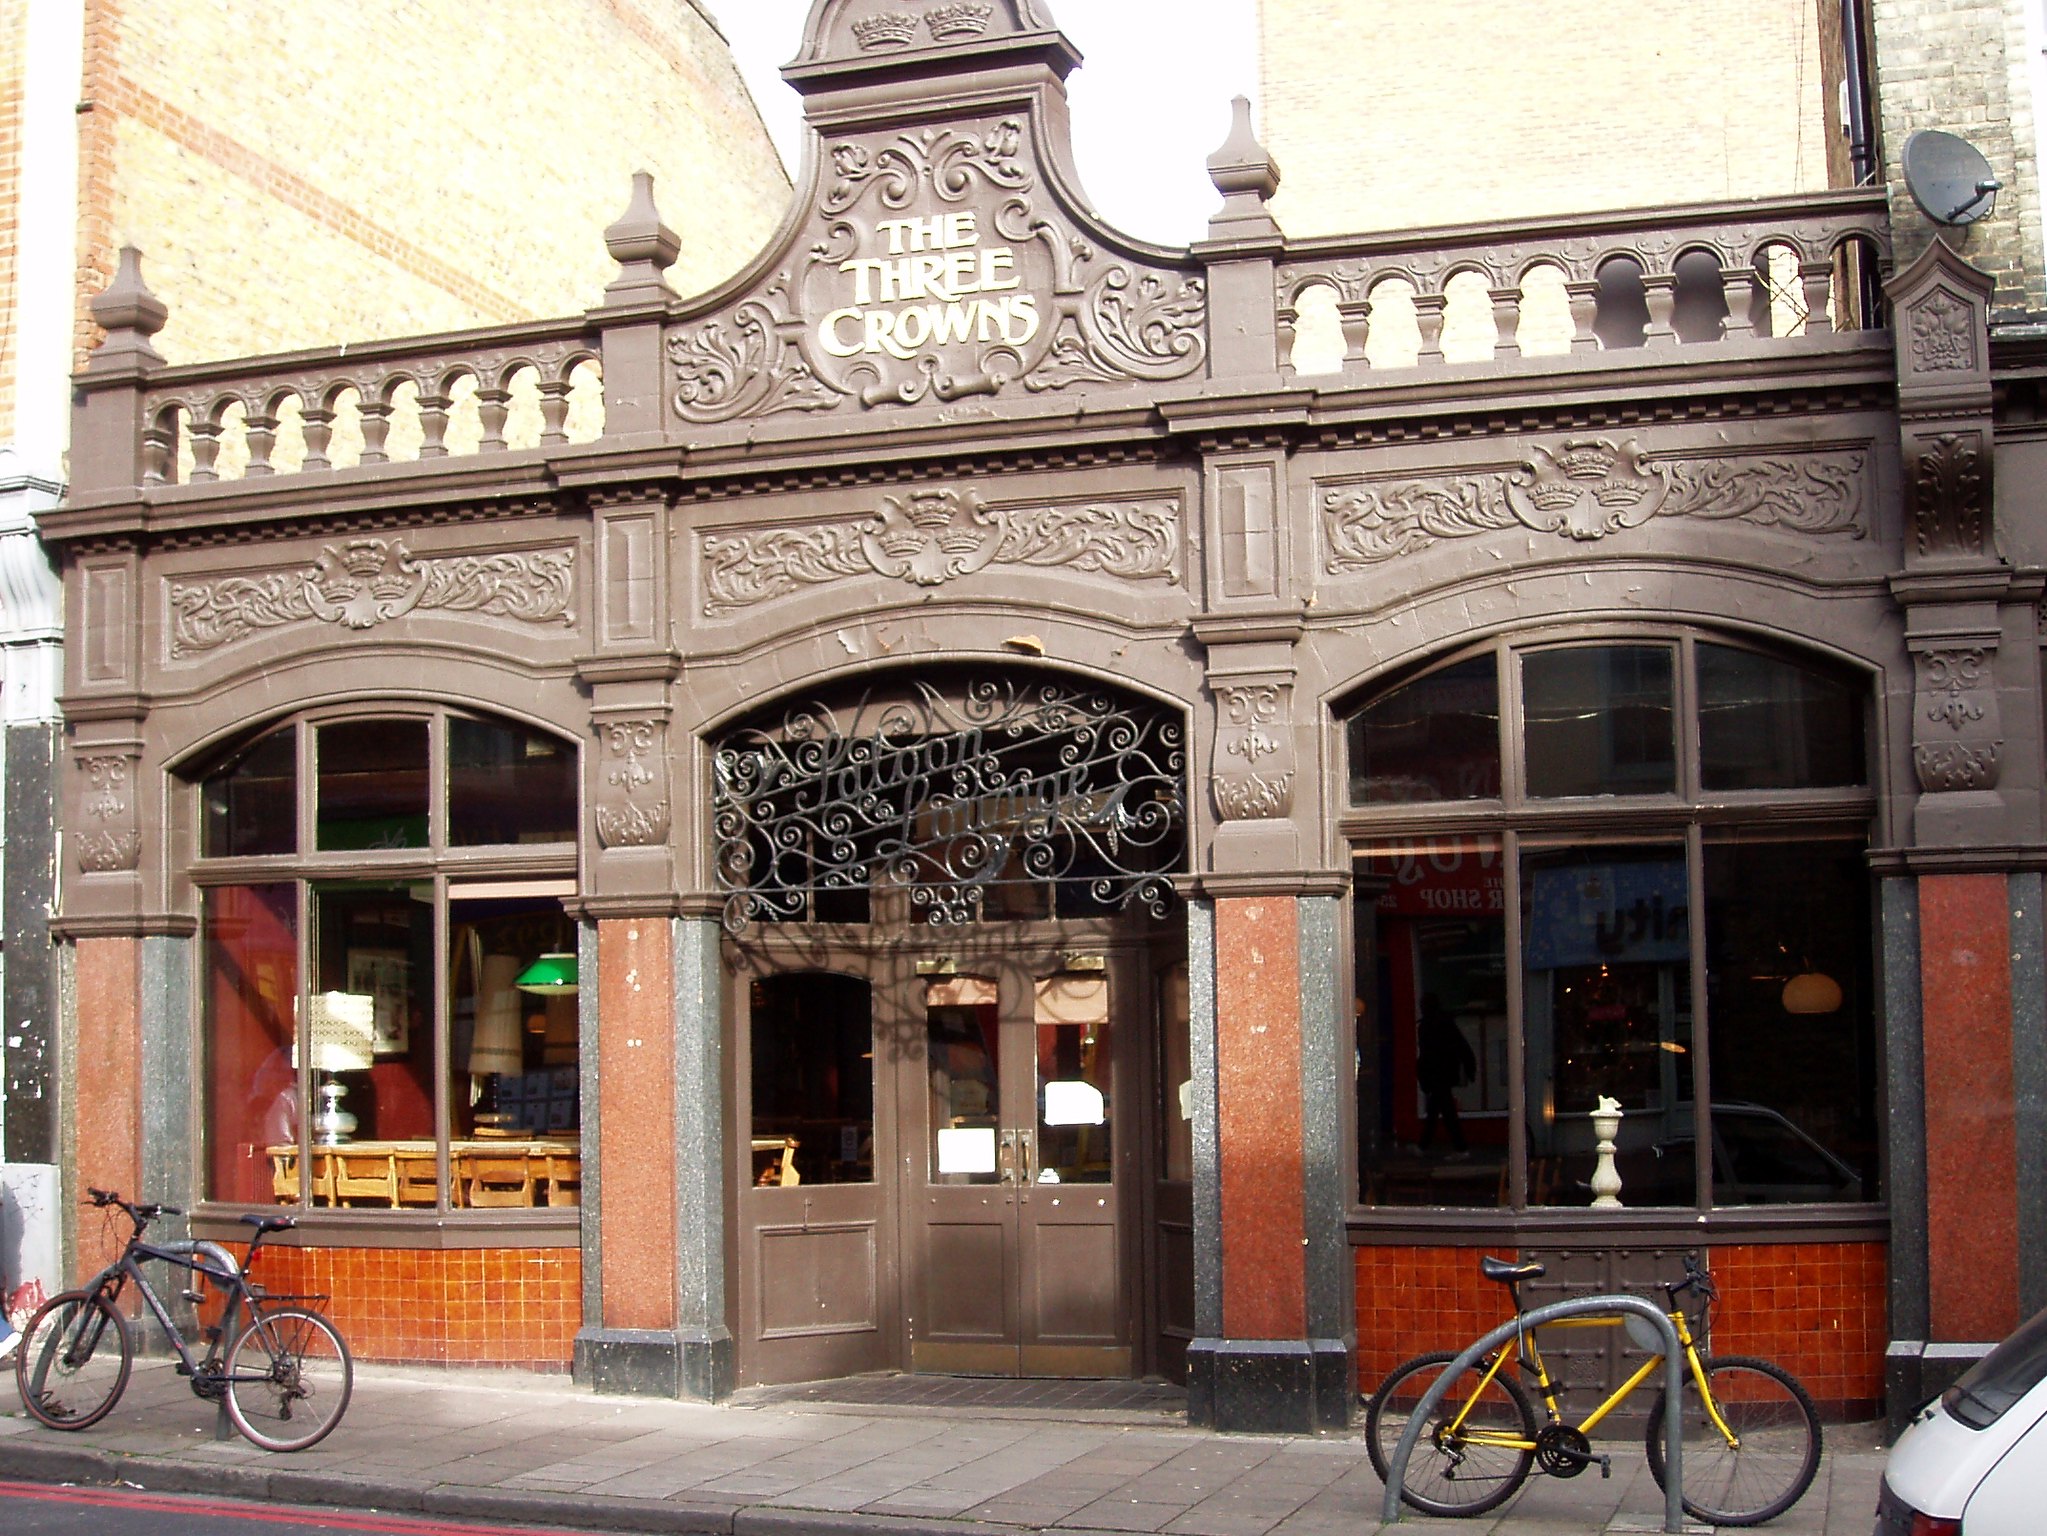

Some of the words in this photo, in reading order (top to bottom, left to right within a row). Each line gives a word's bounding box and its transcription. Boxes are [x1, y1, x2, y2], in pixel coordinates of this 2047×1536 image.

[876, 212, 980, 255] THE
[838, 247, 1021, 305] THREE
[818, 295, 1040, 360] CROWNS
[795, 729, 988, 813] Saloon
[876, 764, 1094, 857] Lounge
